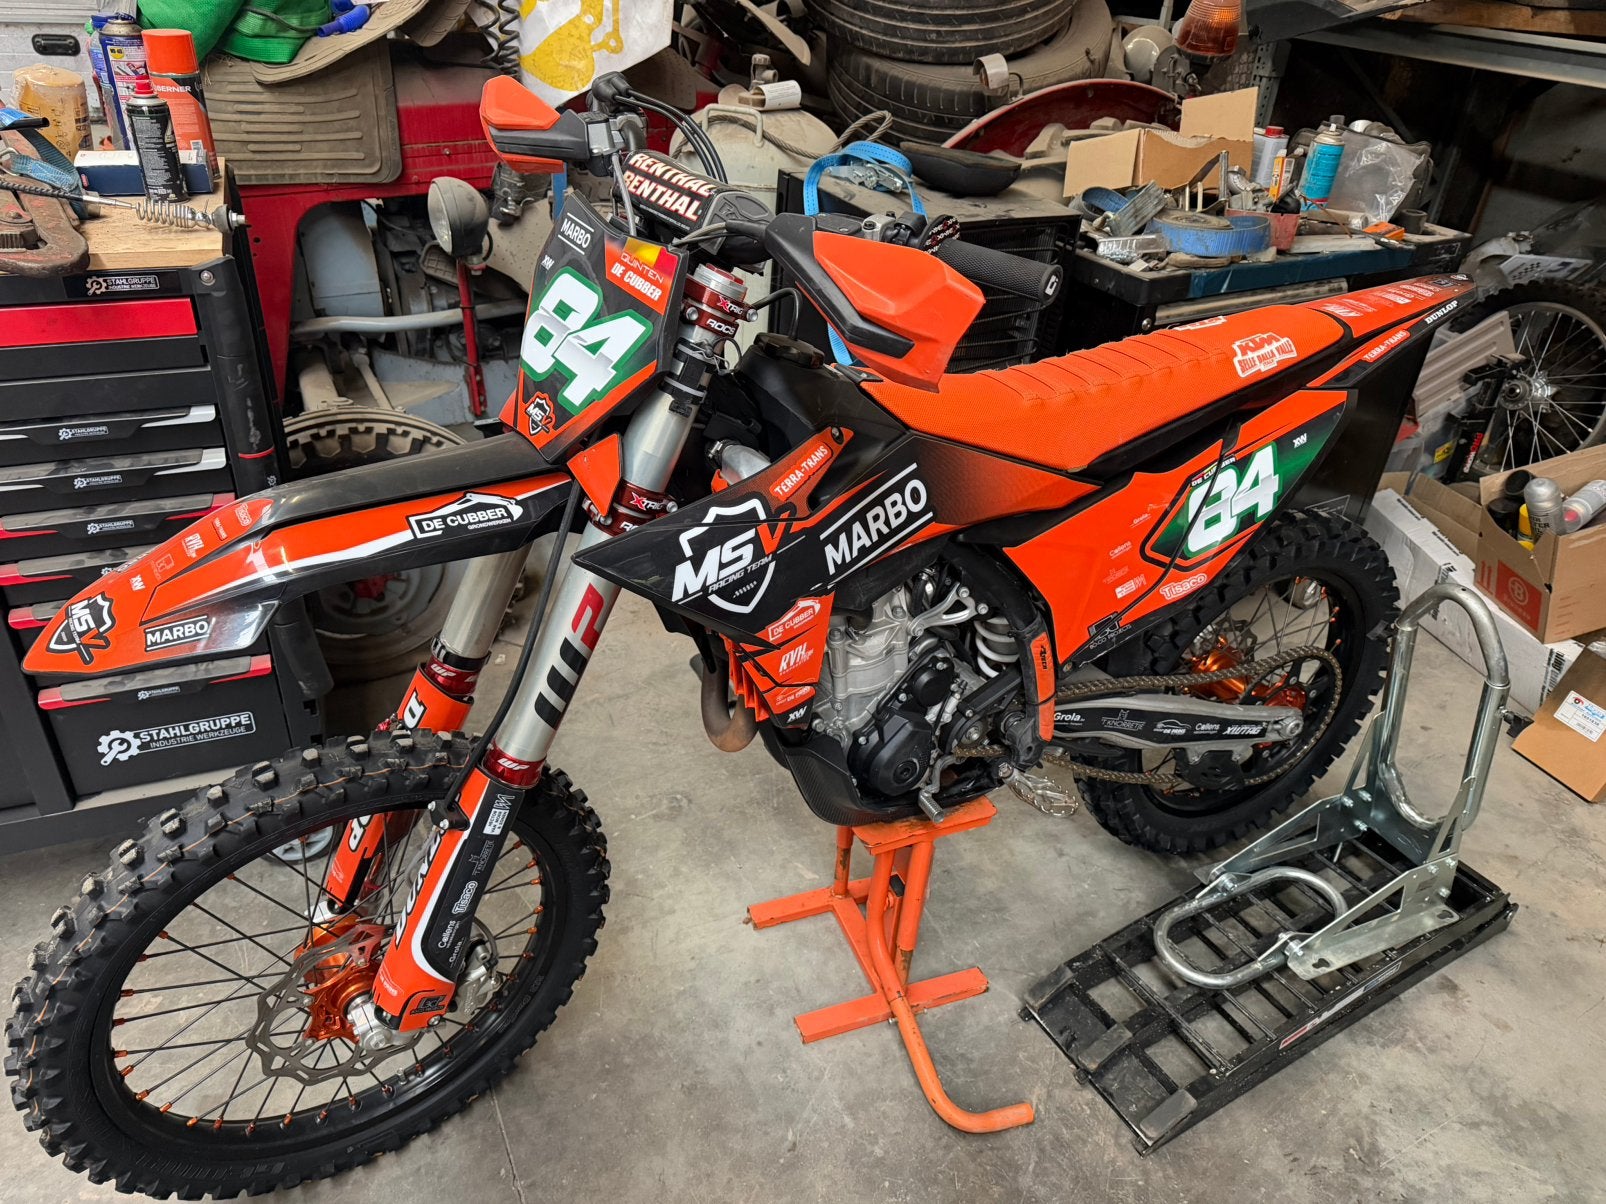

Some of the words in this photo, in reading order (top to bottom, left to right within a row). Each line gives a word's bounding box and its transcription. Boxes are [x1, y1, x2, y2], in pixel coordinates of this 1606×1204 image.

[628, 153, 718, 198] RENTHAL
[623, 170, 701, 222] RENTHAL
[560, 218, 591, 248] MARBO
[107, 277, 155, 285] STAHLGRUPPE
[610, 262, 626, 277] DE
[623, 271, 662, 301] CUBBER
[620, 252, 664, 283] QUINTEN
[716, 295, 742, 314] XTRIG
[1425, 300, 1458, 324] DUNLOP
[521, 272, 646, 407] 84
[706, 318, 736, 334] ROCS
[1236, 334, 1281, 357] KTM
[1364, 330, 1407, 360] TERRA-TRANS
[774, 446, 829, 497] TERRA-TRANS
[630, 492, 664, 511] XTRIG
[1188, 444, 1279, 552] 84
[421, 518, 446, 531] DE
[446, 507, 508, 526] CUBBER
[824, 479, 927, 575] MARBO
[708, 569, 745, 593] RACING
[747, 554, 772, 573] TEAM
[1162, 574, 1206, 598] Tisaco
[147, 621, 209, 646] MARBO
[773, 625, 784, 636] DE
[785, 608, 813, 629] CUBBER
[779, 642, 807, 673] RVH
[140, 714, 251, 743] STAHLGRUPPE
[150, 735, 195, 748] INDUSTRIE
[196, 726, 246, 740] WERKZEUGE
[1195, 723, 1220, 731] Callens
[497, 757, 531, 771] WP
[453, 881, 477, 914] Tisaco
